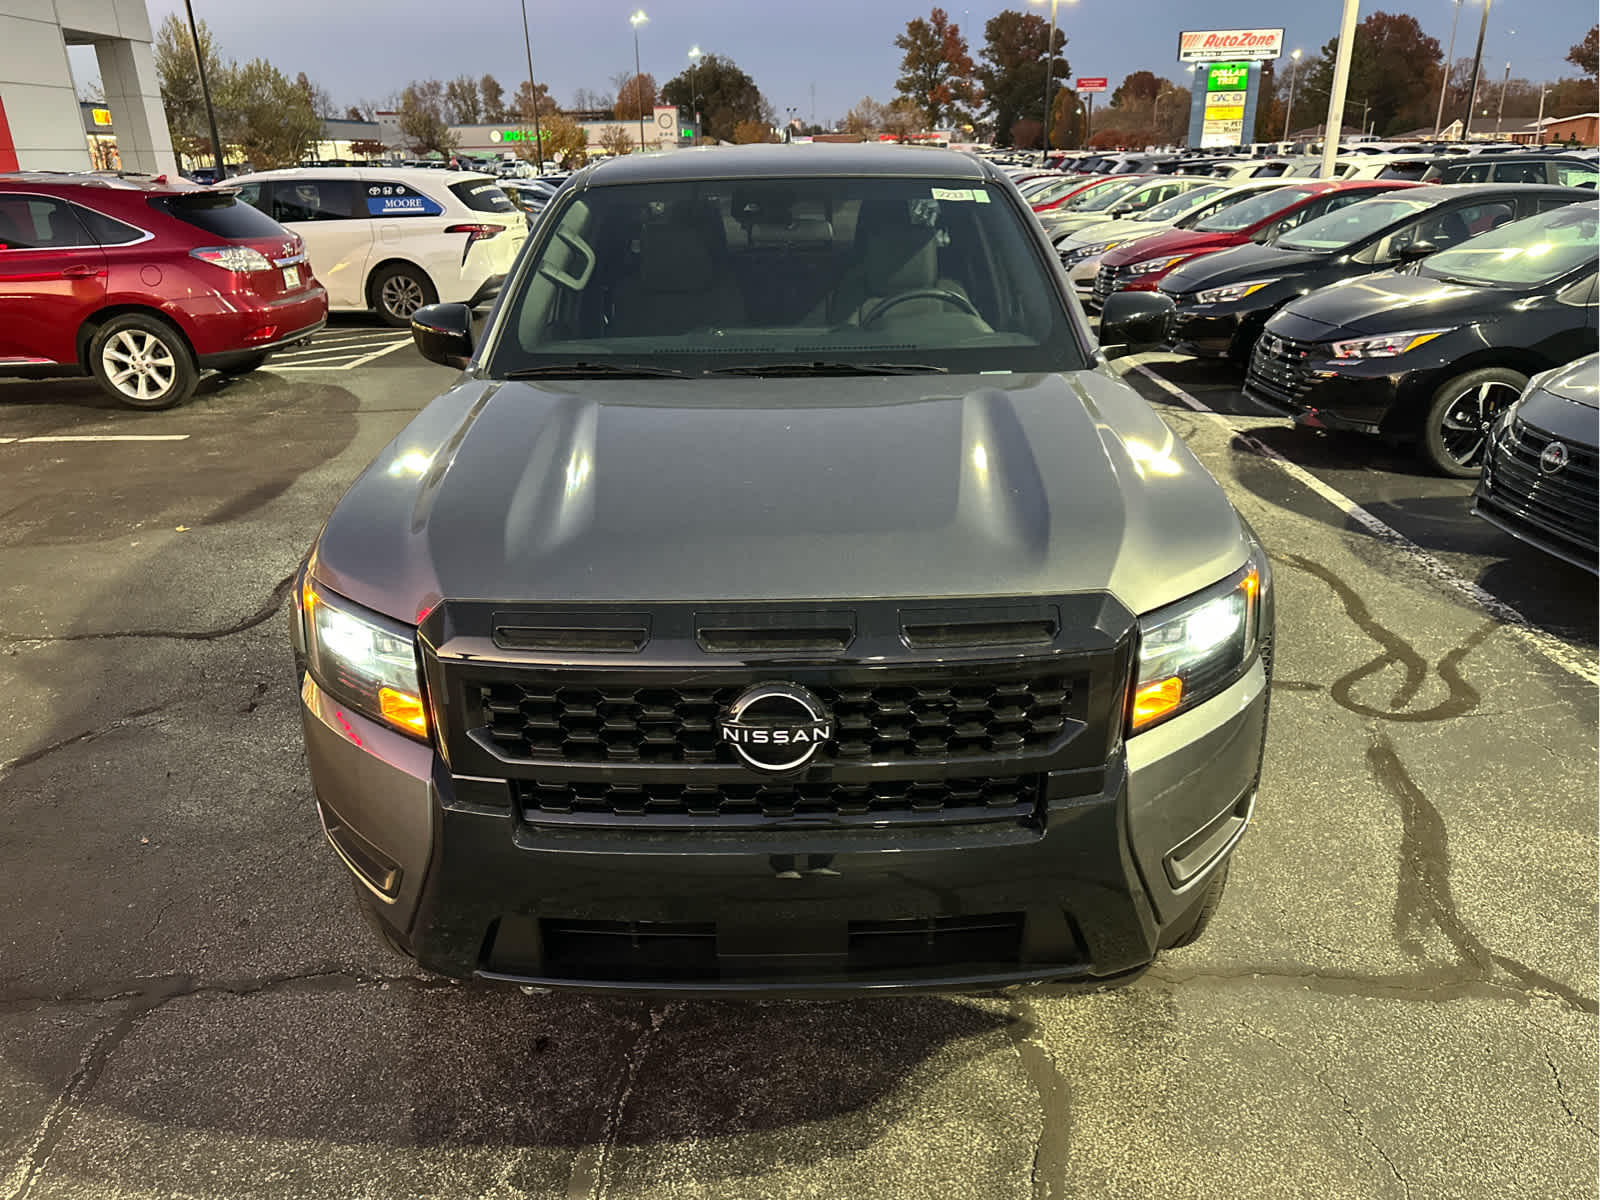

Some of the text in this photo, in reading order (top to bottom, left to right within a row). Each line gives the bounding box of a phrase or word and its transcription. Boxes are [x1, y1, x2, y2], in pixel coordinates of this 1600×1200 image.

[1203, 33, 1275, 48] AutoZone
[1211, 69, 1247, 77] DOLLAR
[1217, 77, 1239, 85] TREE
[384, 198, 423, 209] MOORE
[722, 725, 831, 744] NISSAN
